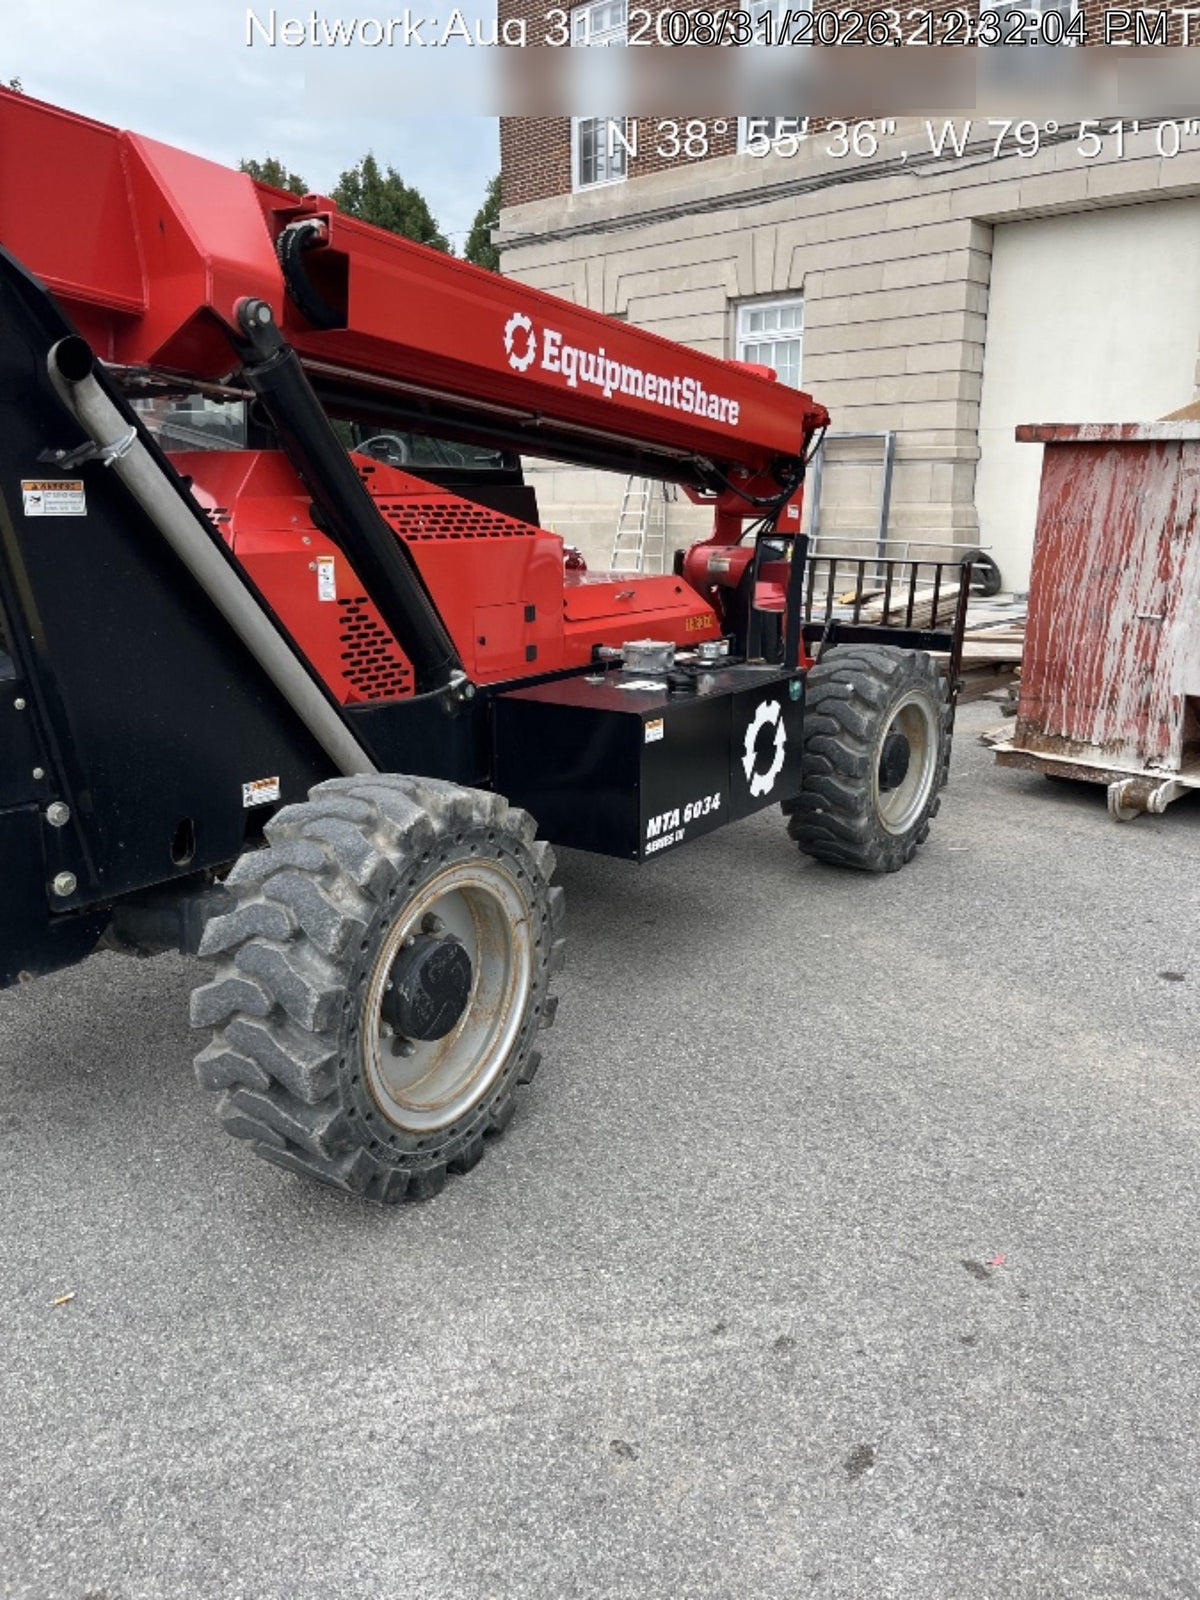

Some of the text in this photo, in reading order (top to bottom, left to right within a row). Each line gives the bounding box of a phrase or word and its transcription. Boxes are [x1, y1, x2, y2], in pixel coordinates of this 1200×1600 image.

[541, 328, 740, 426] EquipmentShare
[646, 792, 721, 839] MTA 6034
[645, 832, 675, 855] SERIES
